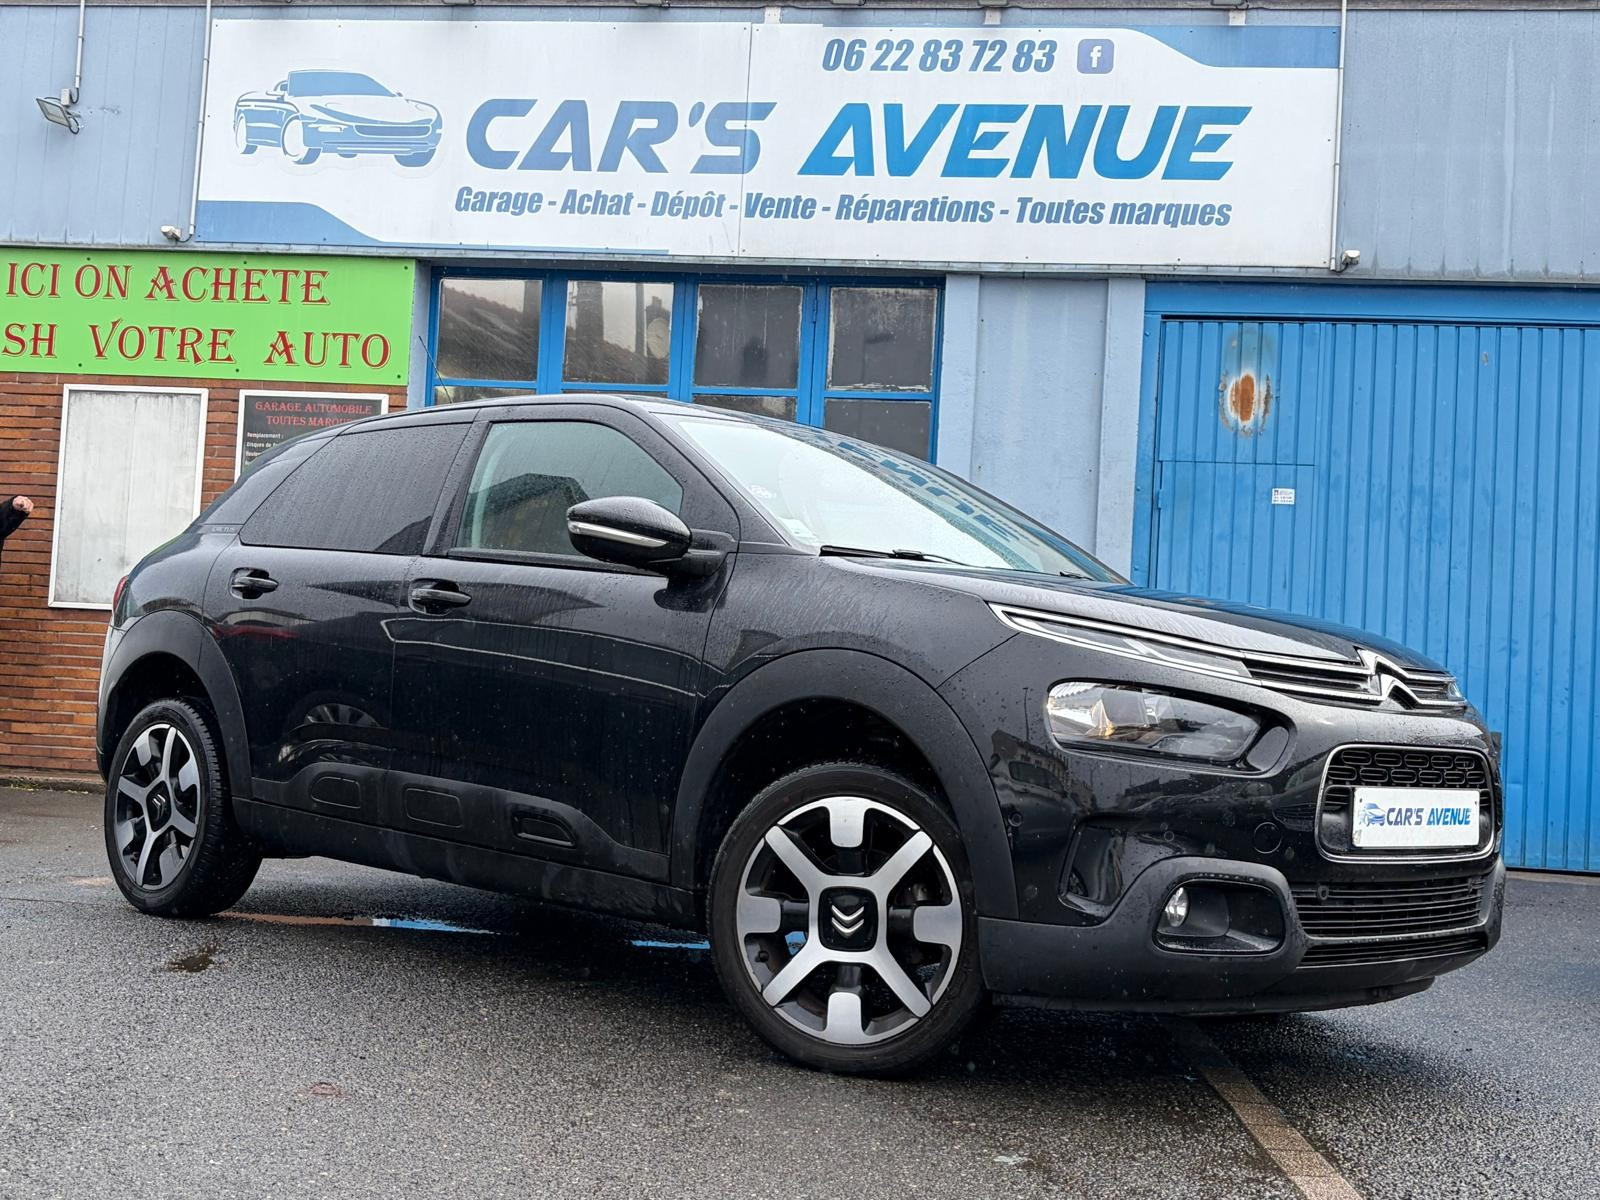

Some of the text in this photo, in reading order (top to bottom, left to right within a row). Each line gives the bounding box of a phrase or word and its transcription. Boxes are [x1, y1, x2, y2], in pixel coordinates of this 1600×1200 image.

[822, 38, 1058, 73] 06 22 83 72 83
[466, 98, 1253, 181] CAR'S AVENUE
[454, 186, 543, 217] Garage
[559, 189, 634, 216] Achat
[650, 190, 726, 220] Dépôt
[744, 192, 817, 219] Vente
[835, 193, 994, 224] Réparations
[1016, 196, 1106, 225] Toutes
[1109, 202, 1232, 228] marques
[6, 262, 330, 305] ICI ON ACHETE
[89, 318, 237, 365] VOTRE
[264, 330, 392, 368] AUTO
[255, 401, 373, 415] GARAGE AUTOMOBILE
[266, 415, 307, 426] TOUTES
[1386, 807, 1472, 826] CAR'S AVENUE
